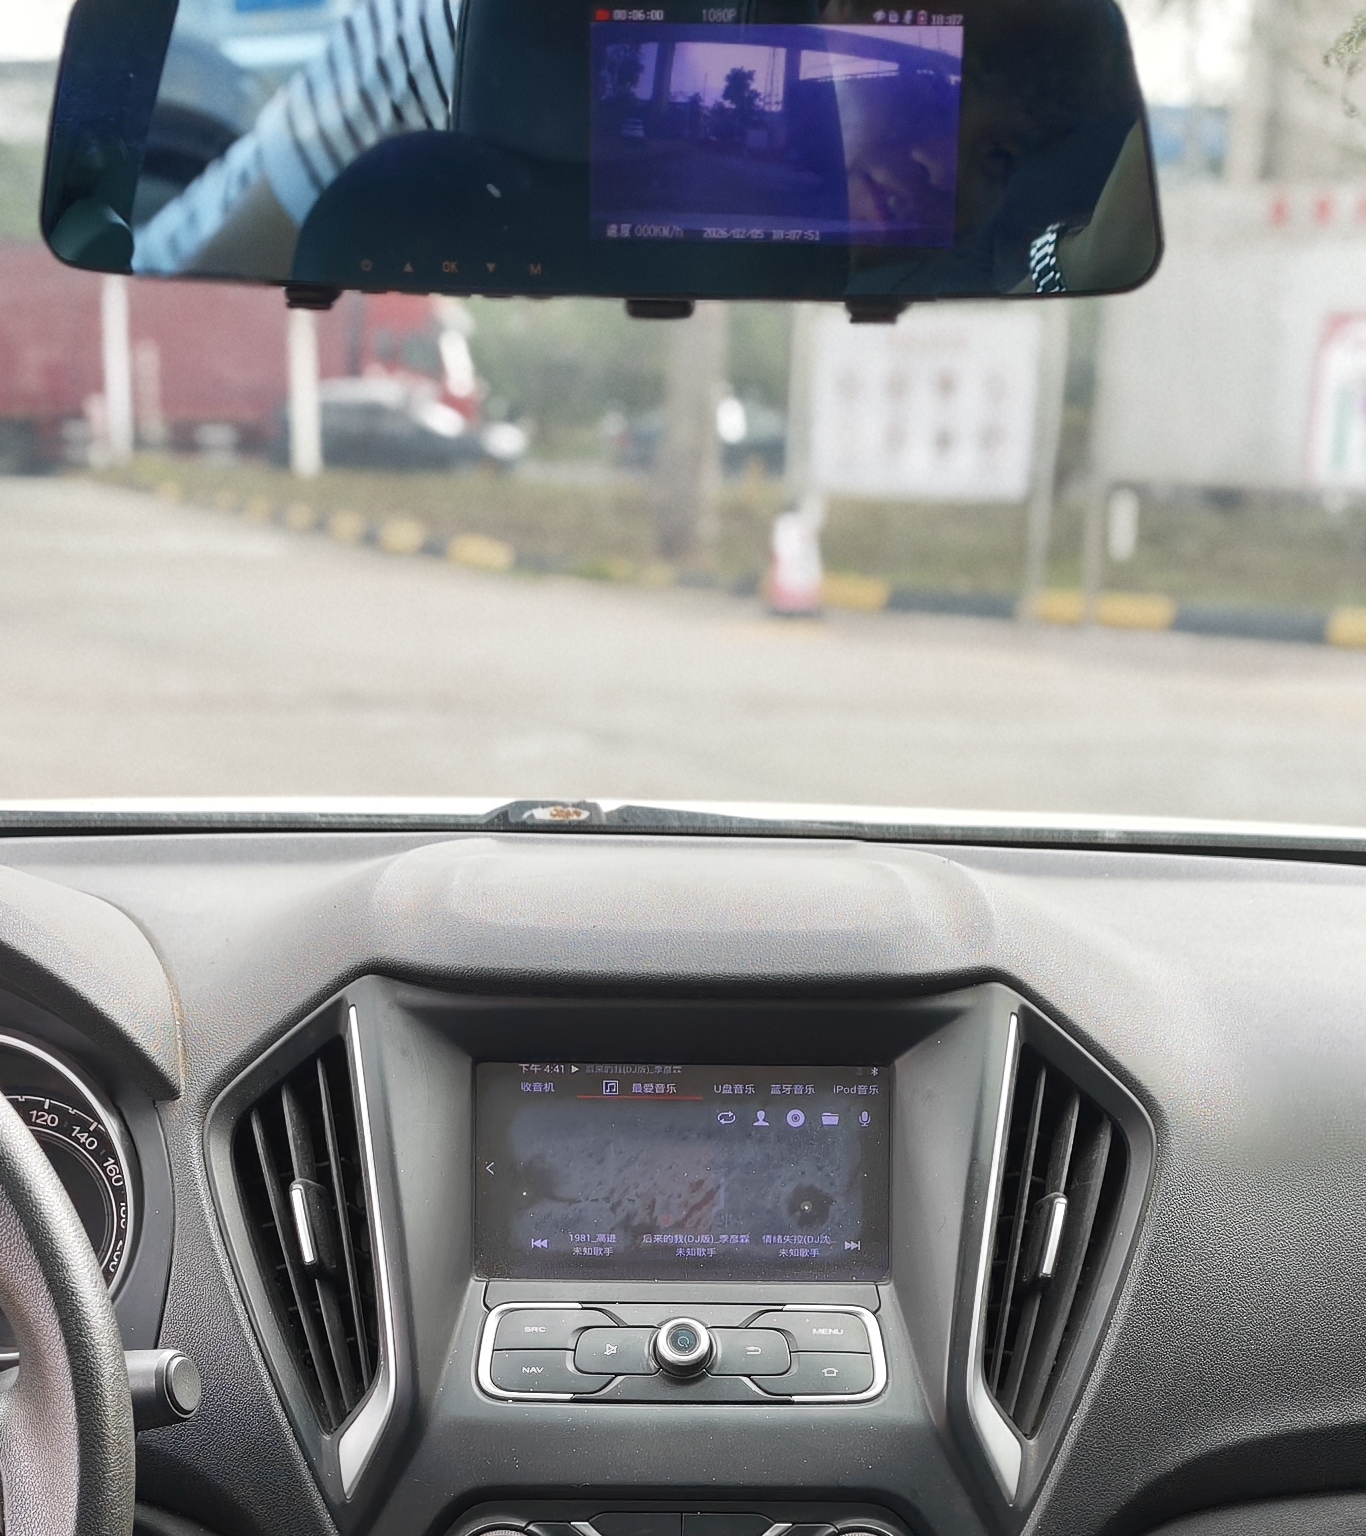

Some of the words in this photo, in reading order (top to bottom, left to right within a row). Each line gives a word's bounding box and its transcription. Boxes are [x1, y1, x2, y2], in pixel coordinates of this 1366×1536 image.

[613, 9, 664, 21] 00:06:00
[442, 261, 458, 273] OK
[529, 263, 542, 275] M
[519, 1063, 541, 1074] 下午
[543, 1064, 565, 1074] 4:41
[520, 1081, 555, 1093] 收音机
[631, 1082, 677, 1094] 最爱音乐
[713, 1083, 756, 1095] U盘音乐
[770, 1084, 816, 1095] 蓝牙音乐
[833, 1084, 880, 1095] iPod音乐
[29, 1110, 58, 1127] 120
[71, 1126, 98, 1150] 140
[103, 1157, 123, 1187] 160
[812, 1328, 844, 1336] MENU
[522, 1366, 544, 1374] NAV
